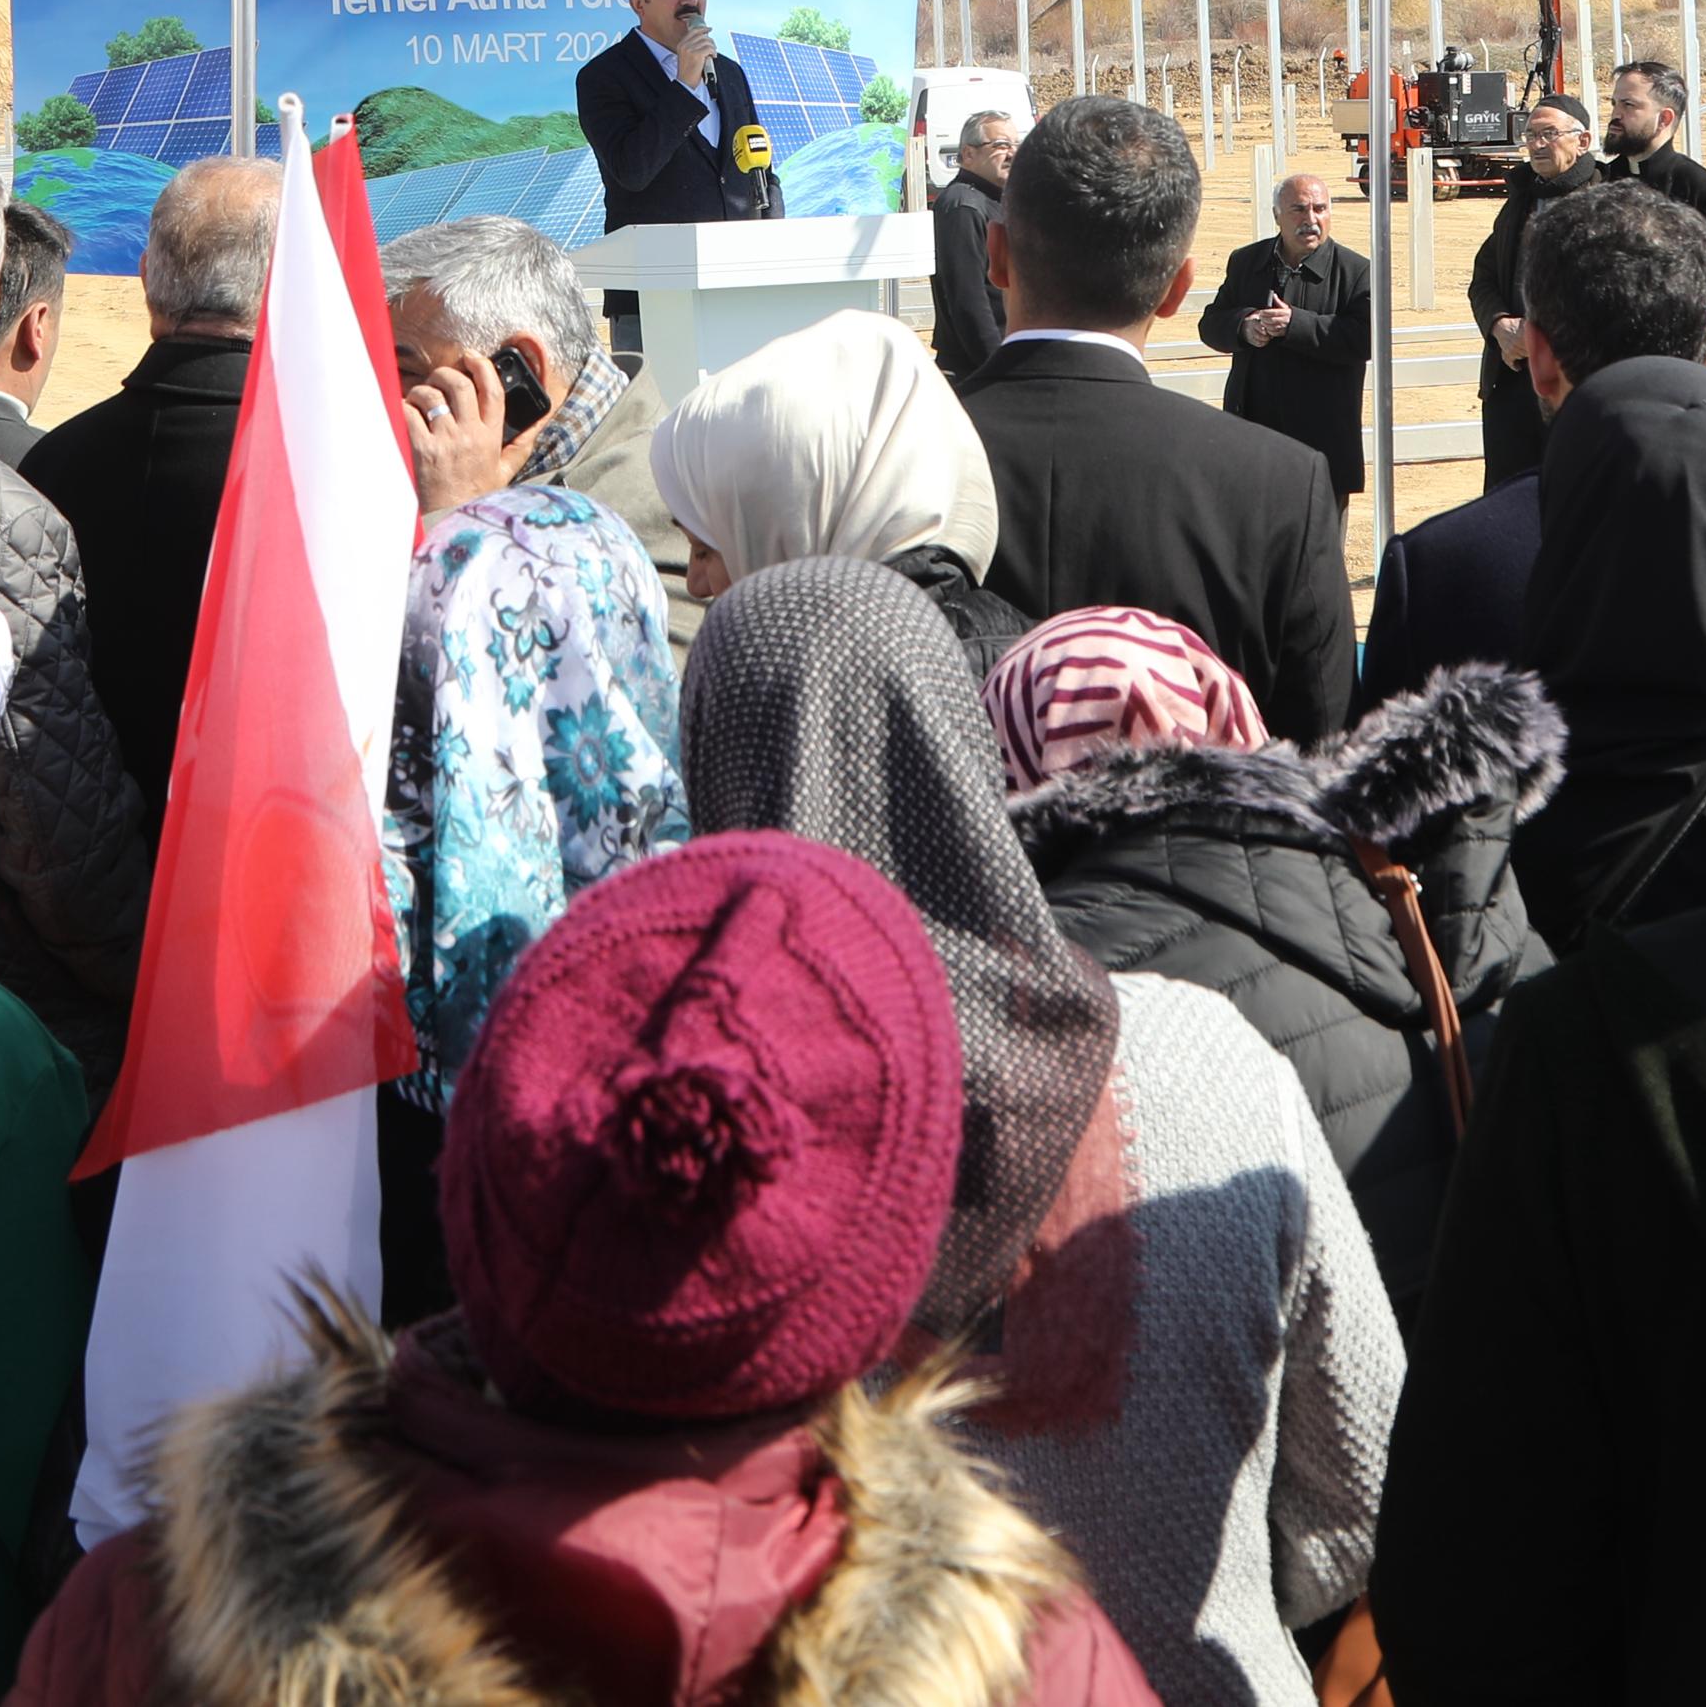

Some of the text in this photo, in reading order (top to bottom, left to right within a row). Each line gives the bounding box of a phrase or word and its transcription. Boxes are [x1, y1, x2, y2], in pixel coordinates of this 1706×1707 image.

[406, 34, 442, 66] 10
[453, 32, 547, 64] MART
[1464, 112, 1501, 123] GAYK
